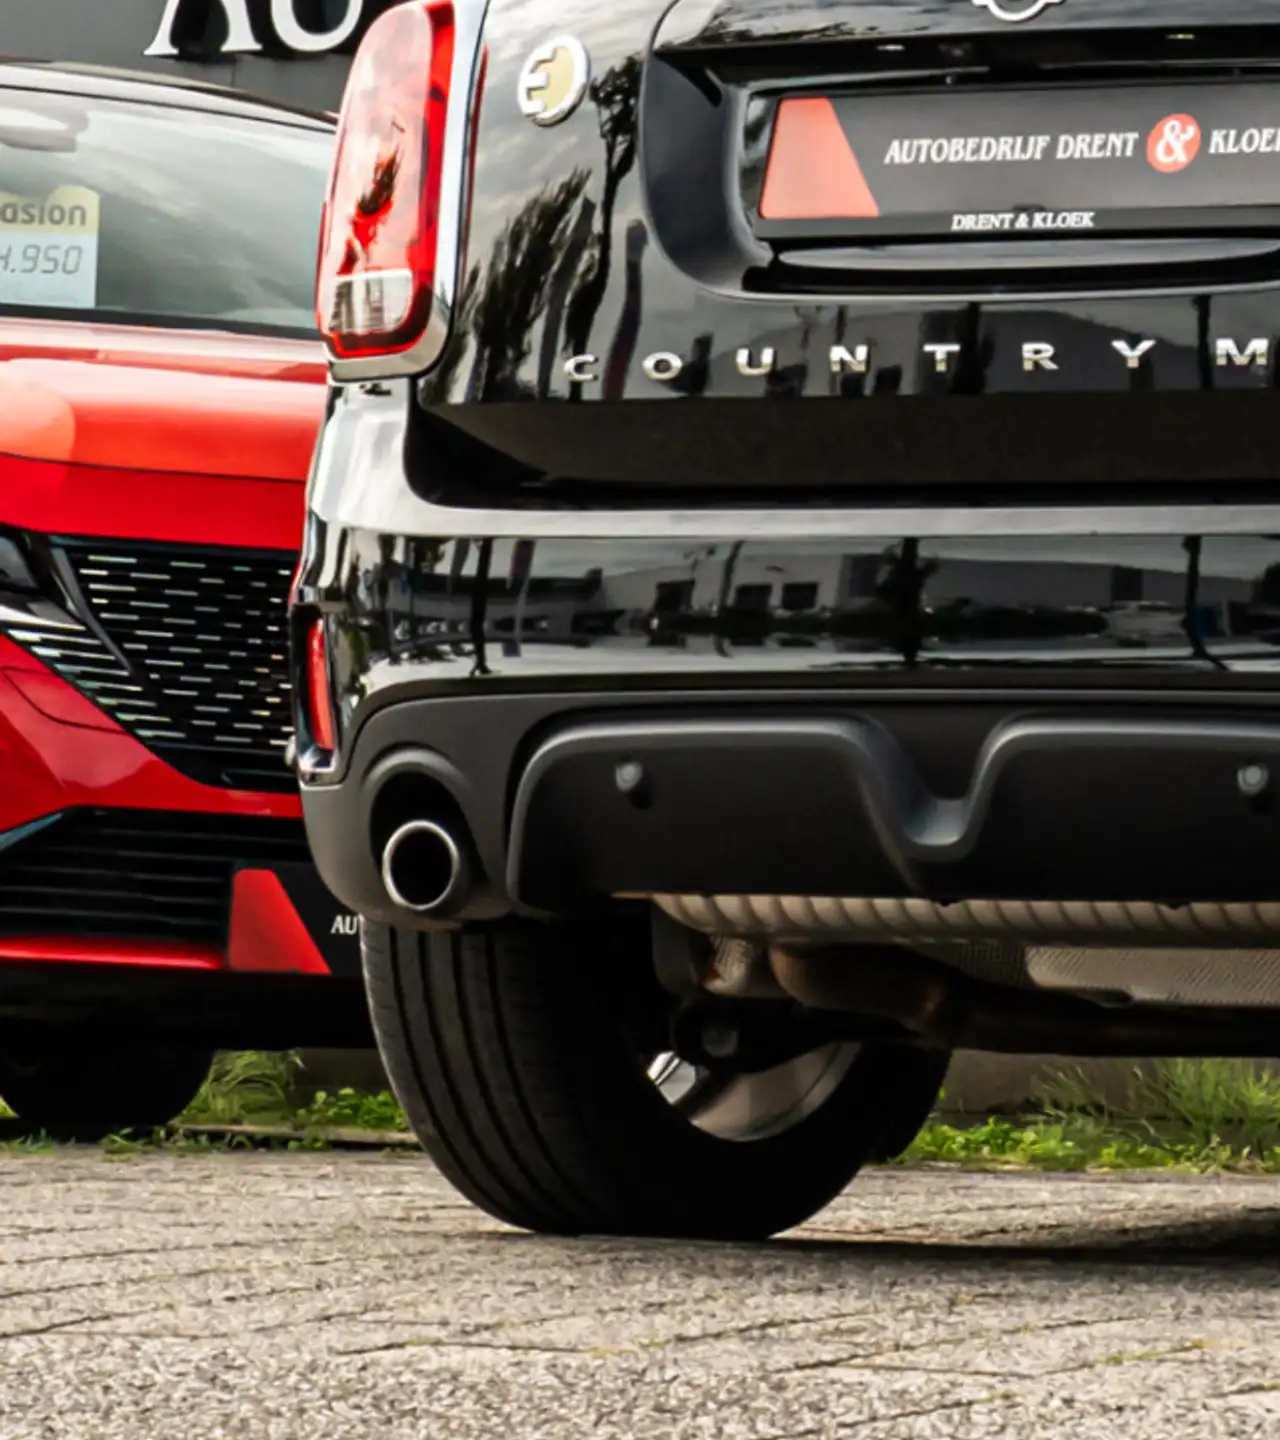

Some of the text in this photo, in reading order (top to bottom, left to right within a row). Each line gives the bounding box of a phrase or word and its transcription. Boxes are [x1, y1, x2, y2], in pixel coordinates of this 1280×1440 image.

[885, 134, 1051, 164] AUTOBEDRIJF
[1056, 131, 1140, 160] DRENT
[1156, 119, 1195, 163] &
[951, 211, 1096, 231] DRENT & KLOEK
